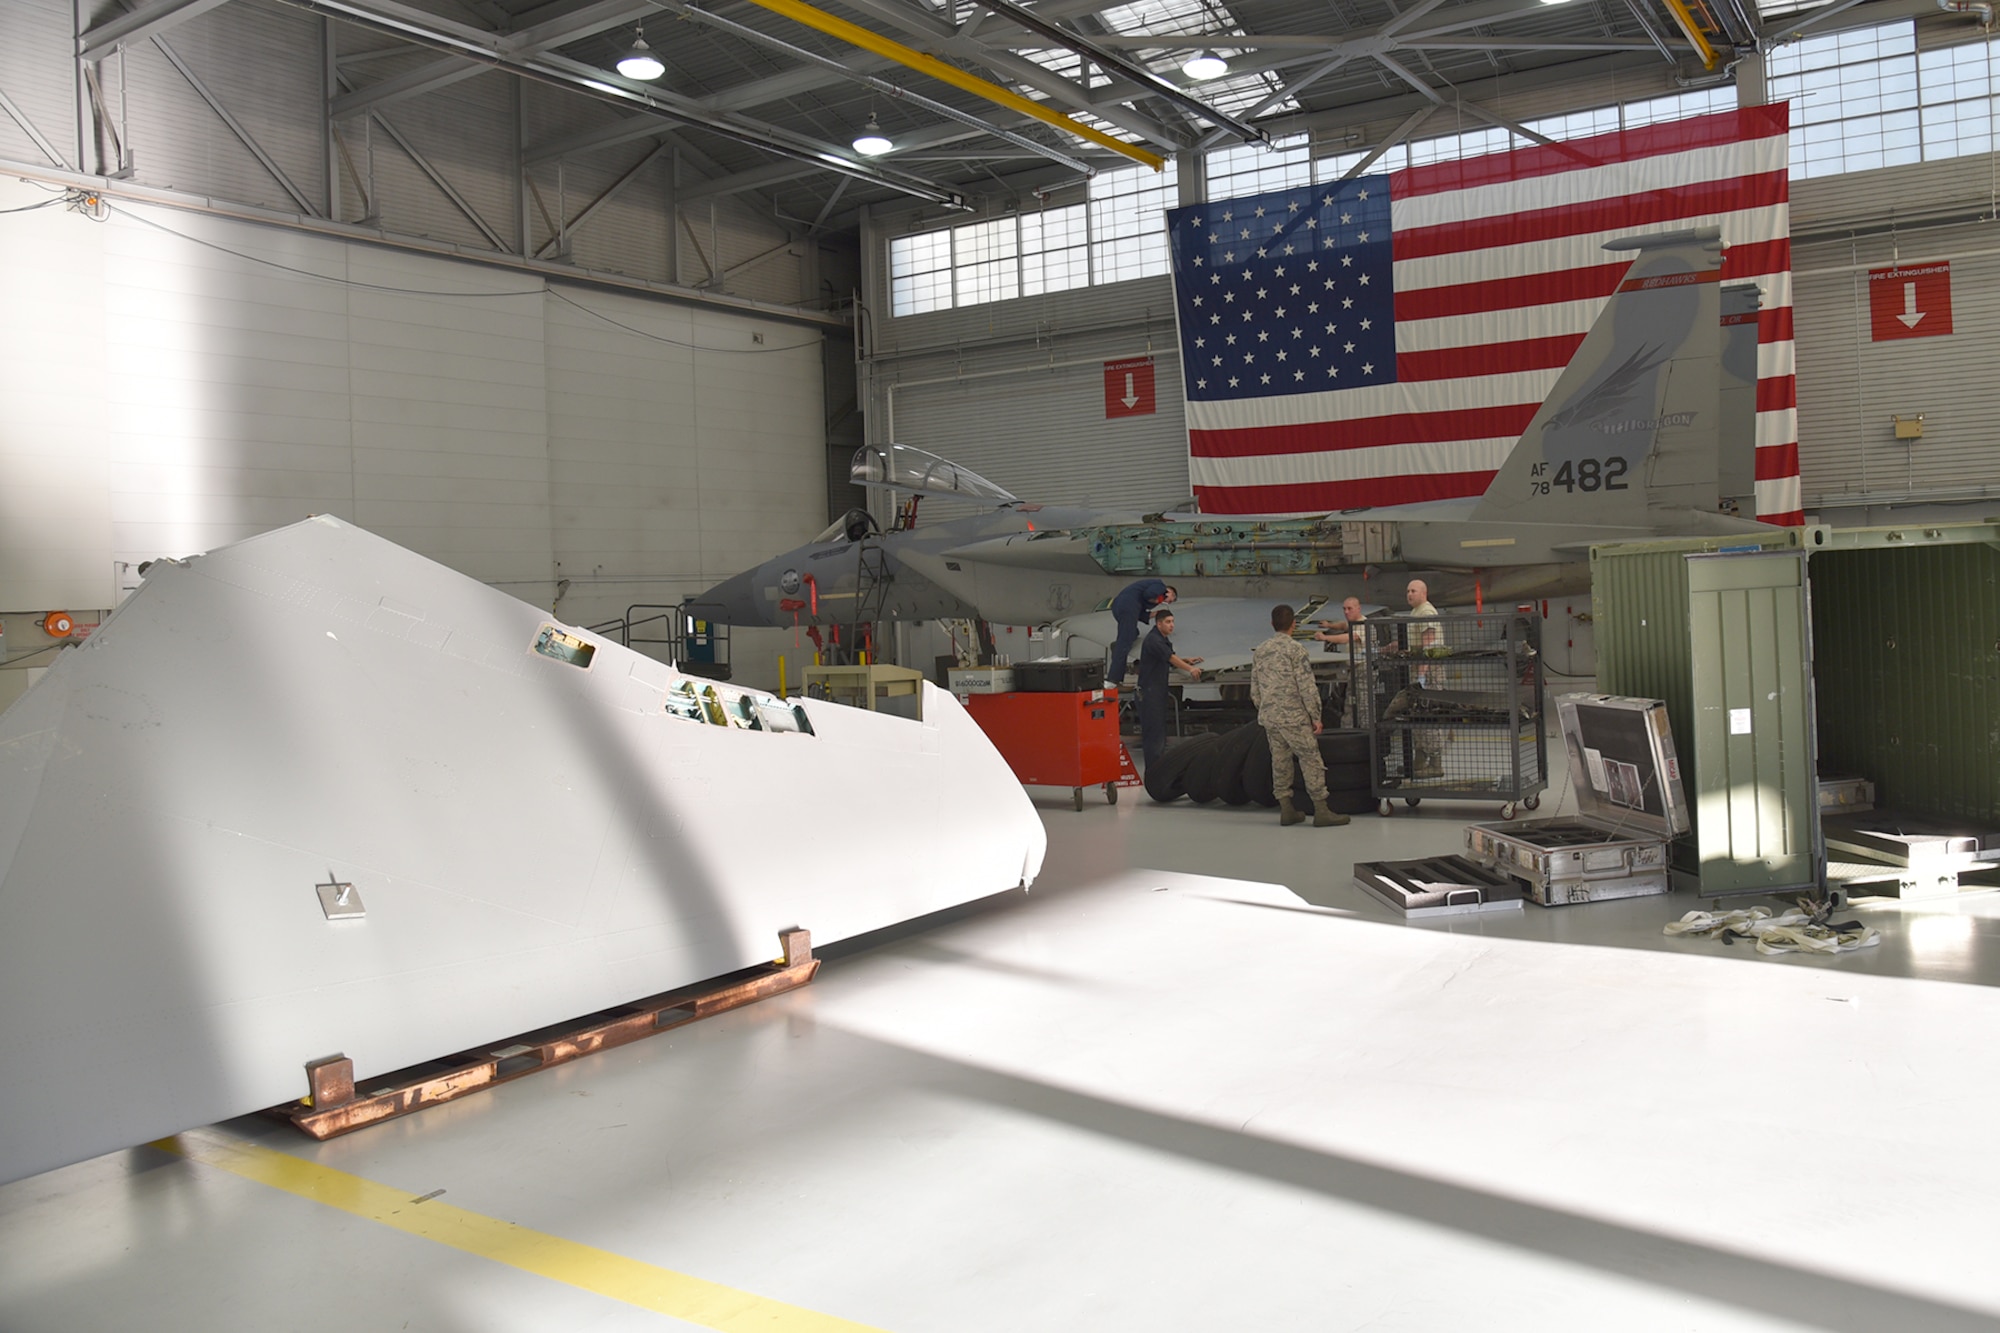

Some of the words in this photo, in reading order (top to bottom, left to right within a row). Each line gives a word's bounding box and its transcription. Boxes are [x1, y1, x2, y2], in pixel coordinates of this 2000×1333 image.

[1869, 272, 1886, 280] FIRE
[1887, 265, 1949, 279] EXTINGUISHER
[1642, 274, 1697, 289] REDHAWKS
[1116, 360, 1154, 369] EXTINGUISHER
[1637, 415, 1690, 430] OREGON
[1531, 462, 1549, 477] AF
[1553, 456, 1629, 493] 482
[1531, 481, 1550, 496] 78
